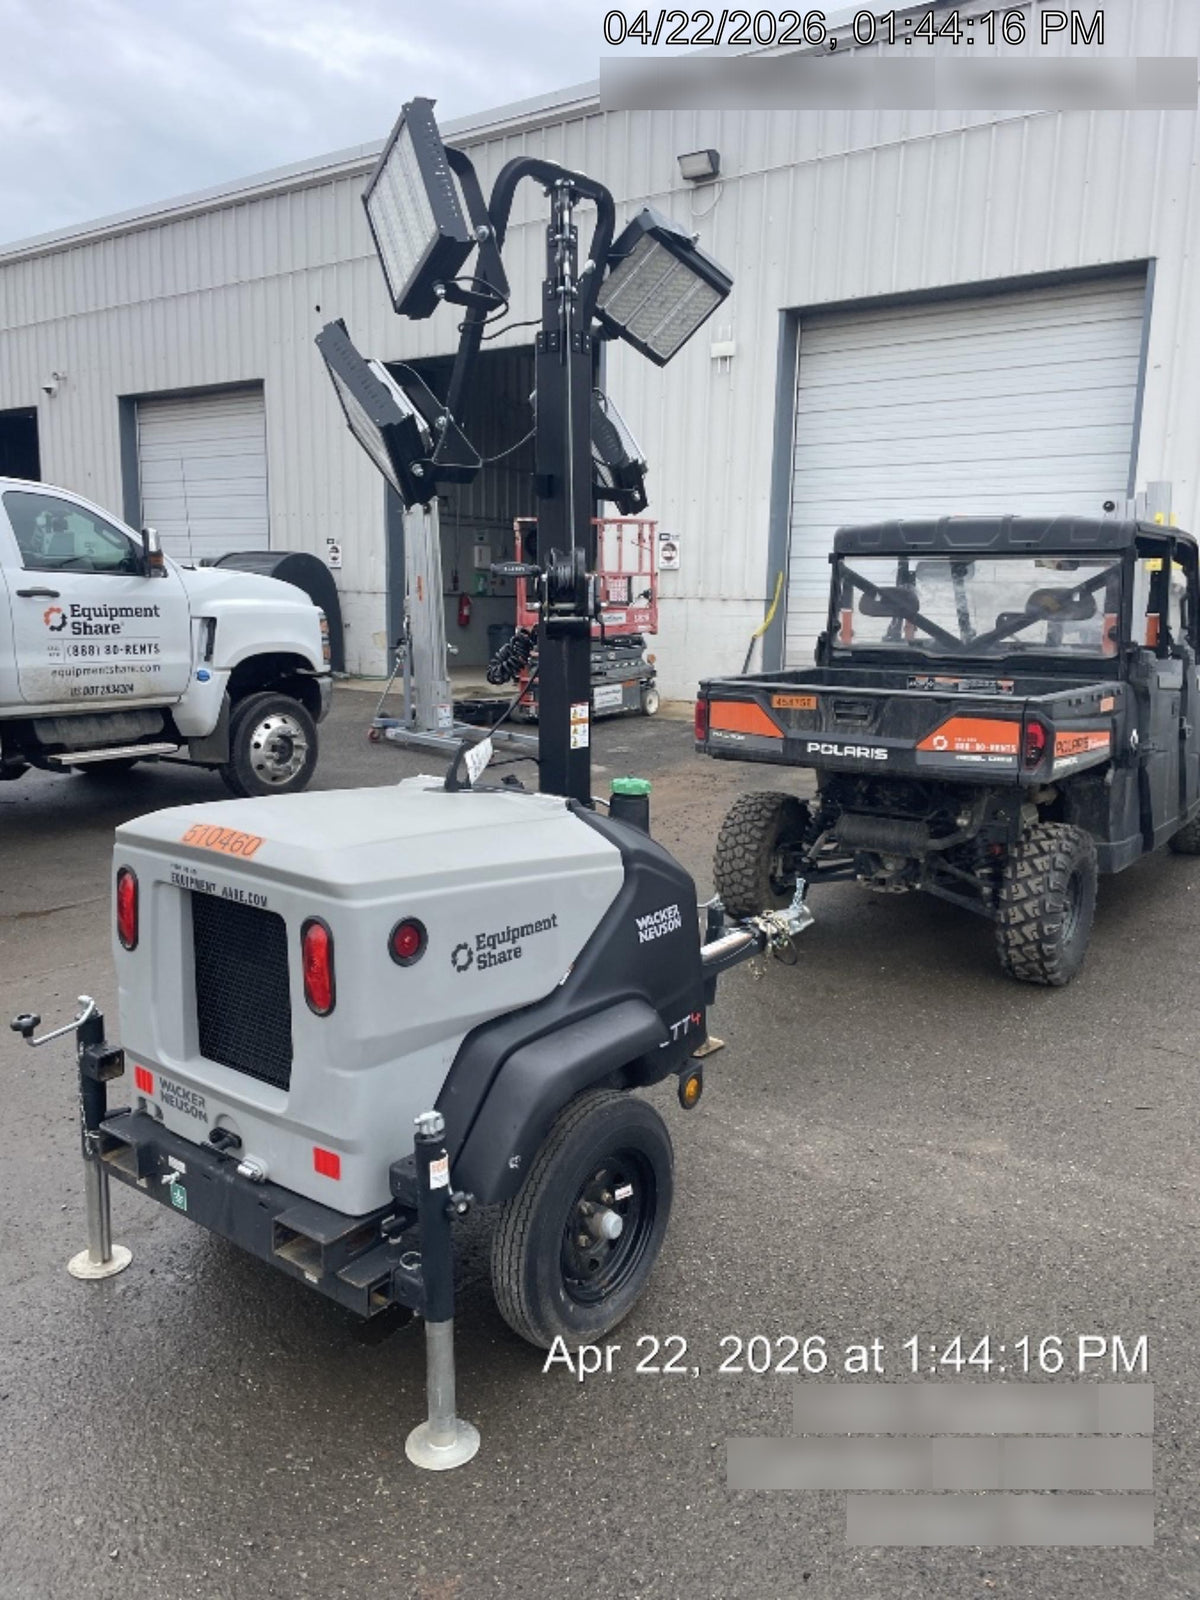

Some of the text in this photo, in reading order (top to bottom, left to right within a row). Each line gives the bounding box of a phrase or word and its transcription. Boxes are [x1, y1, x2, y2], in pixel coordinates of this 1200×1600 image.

[69, 603, 160, 620] Equipment
[71, 621, 121, 635] Share
[806, 742, 888, 761] POLARIS
[635, 903, 680, 931] WACKER
[638, 916, 682, 943] NEUSON
[475, 913, 558, 952] Equipment
[477, 945, 523, 971] Share
[659, 1011, 702, 1048] TT4
[159, 1076, 206, 1109] WACKER
[160, 1090, 209, 1124] NEUSON
